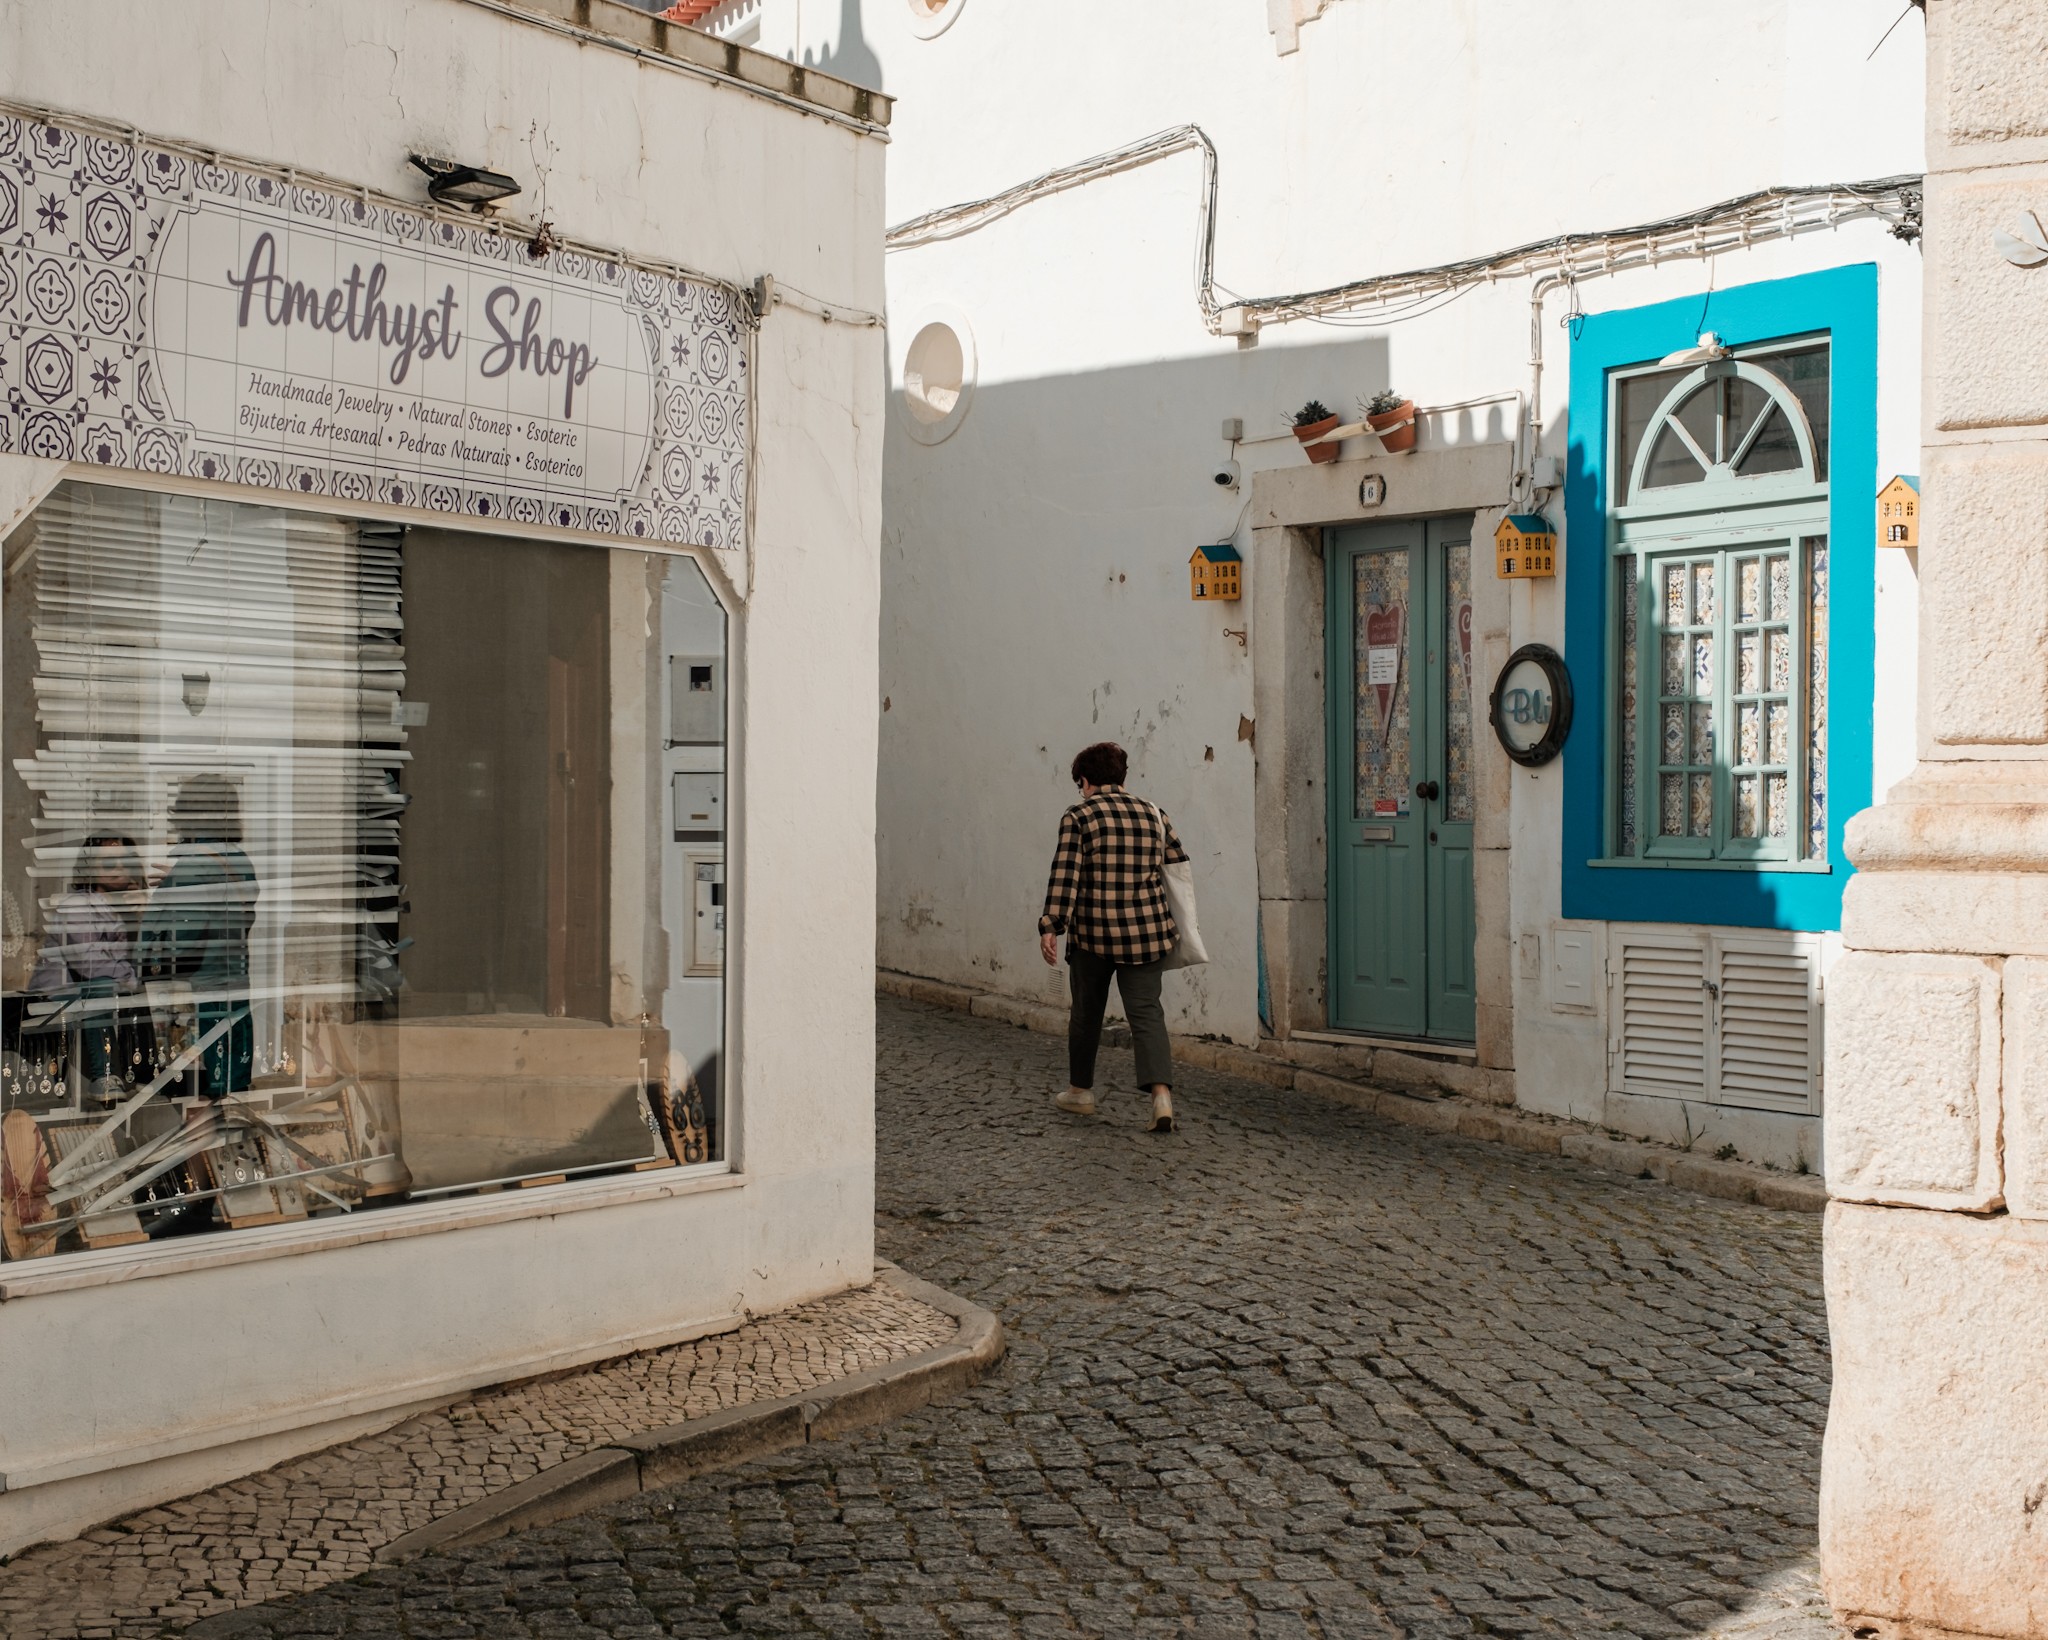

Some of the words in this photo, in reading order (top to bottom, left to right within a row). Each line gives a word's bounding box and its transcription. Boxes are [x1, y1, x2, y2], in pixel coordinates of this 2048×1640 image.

[227, 232, 461, 385] Amethyst
[480, 286, 599, 419] Shop
[239, 404, 306, 433] Bijuteria
[309, 417, 384, 447] Artesanal
[397, 430, 447, 456] Pedras
[450, 439, 512, 467] Naturais
[525, 451, 583, 478] Esoterico
[248, 373, 333, 406] Handmade
[334, 388, 394, 422] Jewelry
[408, 401, 465, 429] Natural
[468, 411, 513, 436] Stones
[526, 421, 577, 447] Esoteric
[1367, 486, 1374, 499] 6
